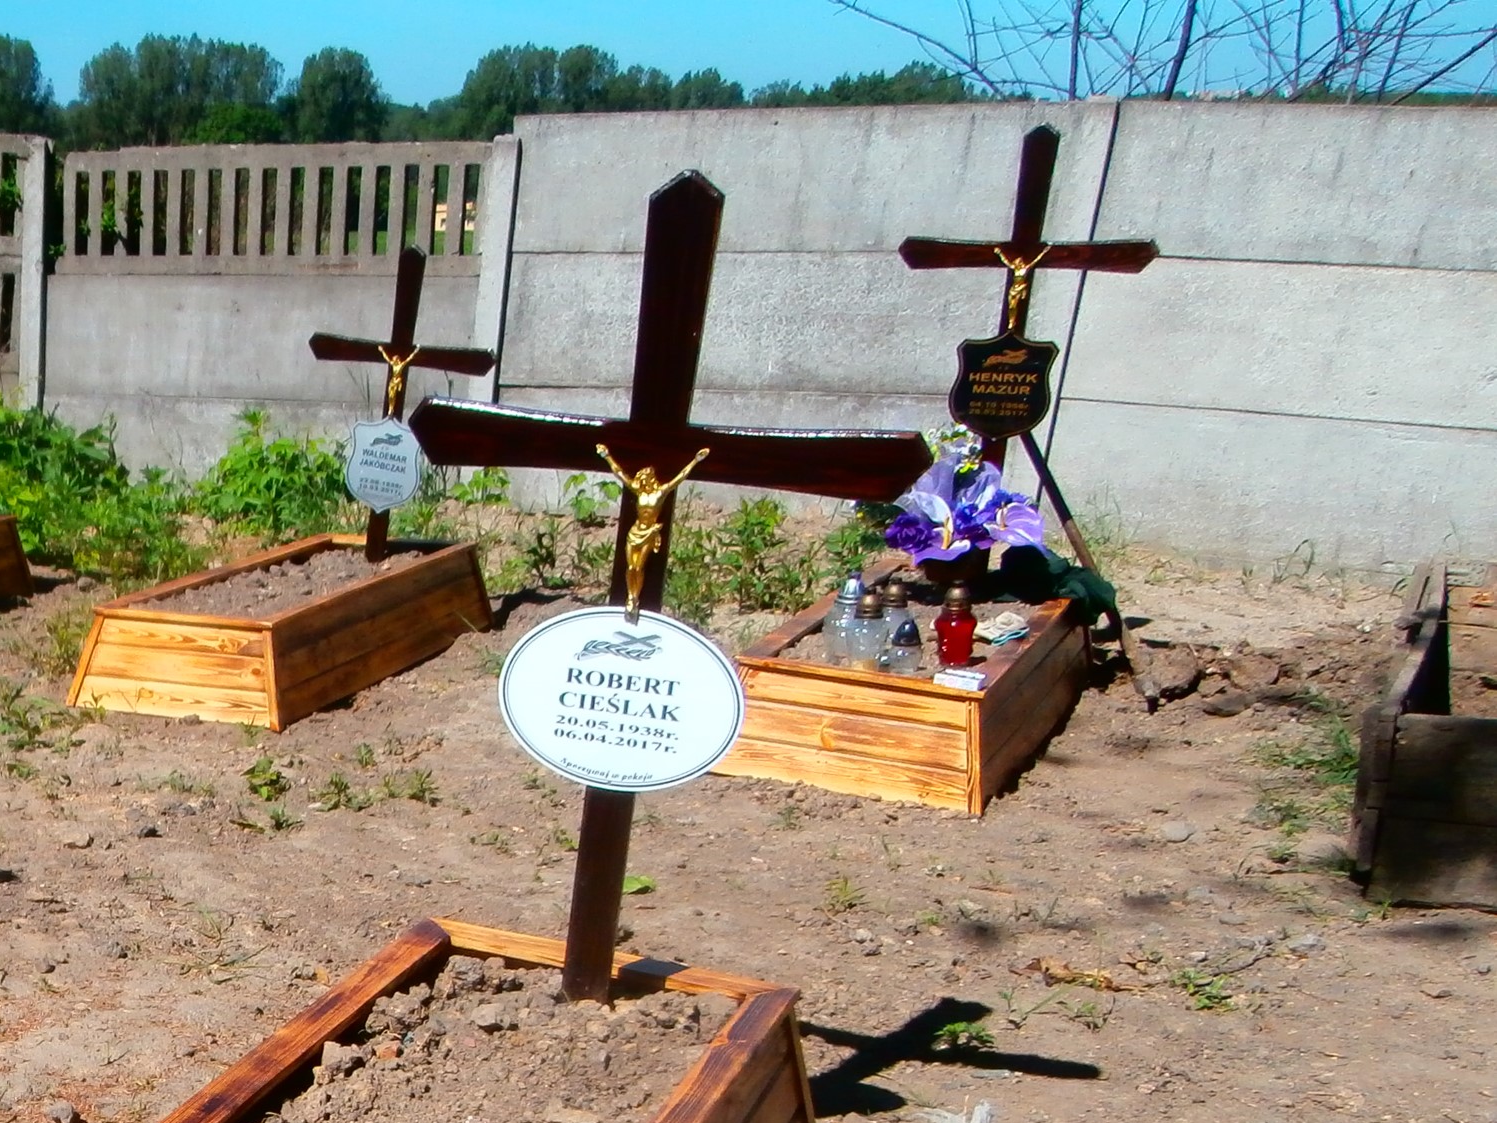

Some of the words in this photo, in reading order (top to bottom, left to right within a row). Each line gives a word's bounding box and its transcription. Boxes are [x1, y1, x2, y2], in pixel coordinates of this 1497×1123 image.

[968, 371, 1039, 384] HENRYK
[972, 384, 1031, 396] MAZUR
[362, 448, 408, 464] WALDEMAR
[566, 667, 681, 697] ROBERT
[558, 690, 681, 723] CIEŚLAK
[553, 727, 678, 755] 06.04.2017r.
[555, 714, 680, 741] 20.05.1938r.
